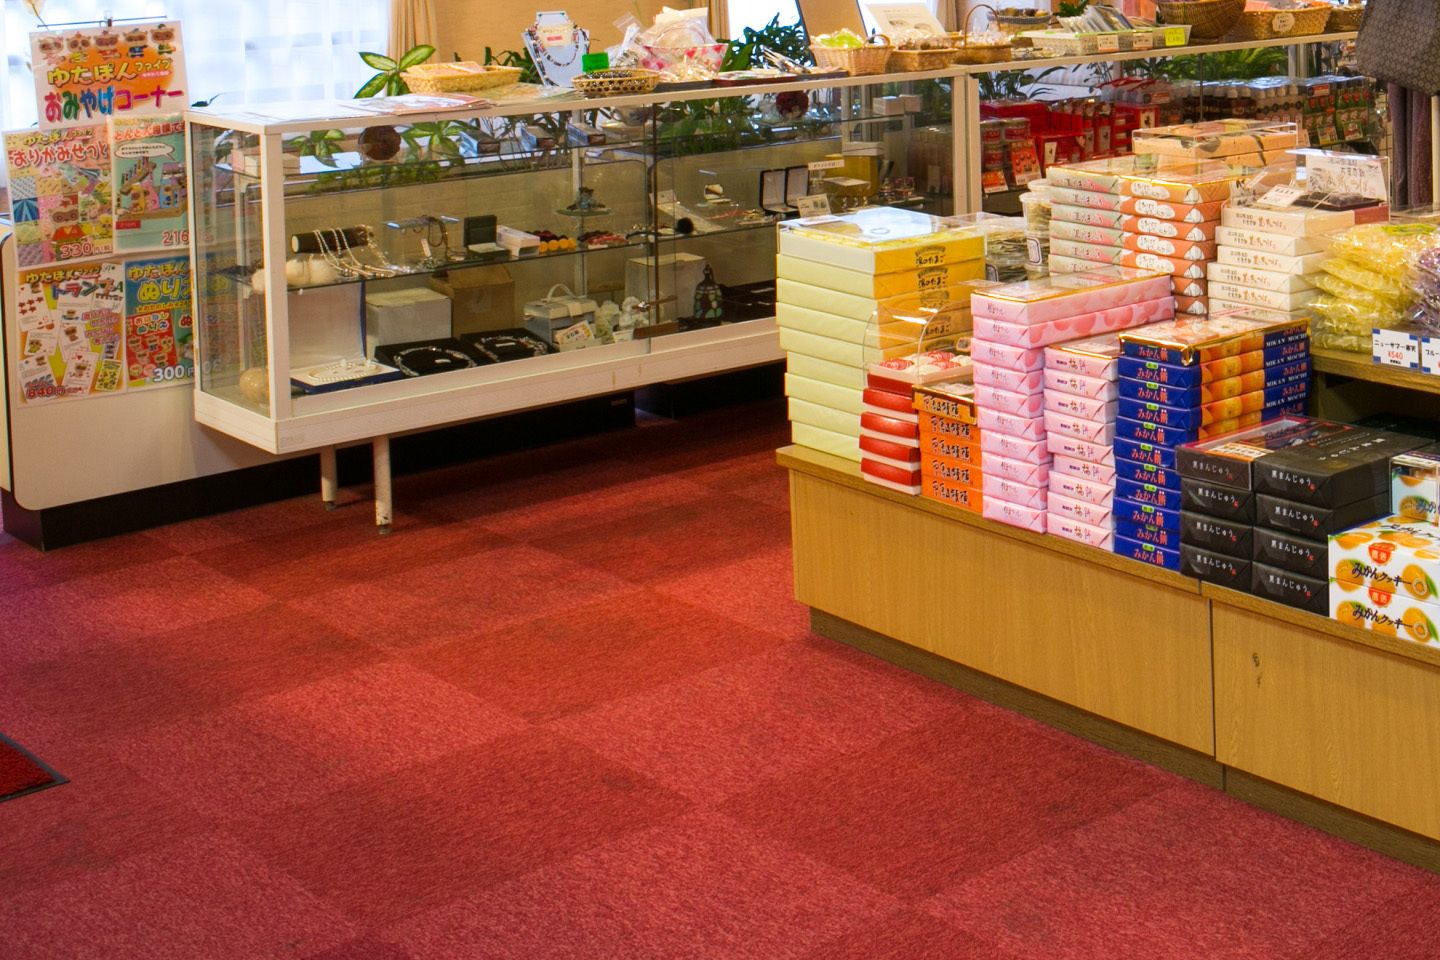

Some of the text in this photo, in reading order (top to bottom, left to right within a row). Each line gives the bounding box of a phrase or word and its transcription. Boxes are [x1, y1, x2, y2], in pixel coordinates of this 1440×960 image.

[44, 84, 184, 123] おみやげコーナー
[1265, 333, 1307, 347] MIKAN MOCHI
[1374, 339, 1417, 353] ニューサマー寒天
[1265, 352, 1306, 367] MIKAN MOCHI
[1387, 351, 1404, 360] ¥540
[1266, 371, 1307, 388] MIKAN MOCHI
[1265, 392, 1307, 408] MIKAN MOCHI
[1193, 460, 1230, 475] 黒まんじゅう
[1271, 470, 1312, 486] 黒まんじゅう
[1198, 488, 1236, 503] 黒まんじゅう
[1275, 506, 1315, 522] 黒まんじゅう
[1196, 522, 1234, 537] 黒まんじゅう
[1271, 540, 1311, 557] 黒まんじゅう
[1196, 554, 1234, 571] 黒まんじゅう
[1350, 561, 1413, 588] みかんクッキー
[1269, 575, 1308, 593] 黒まんじゅう
[1352, 604, 1413, 630] みかんクッキー
